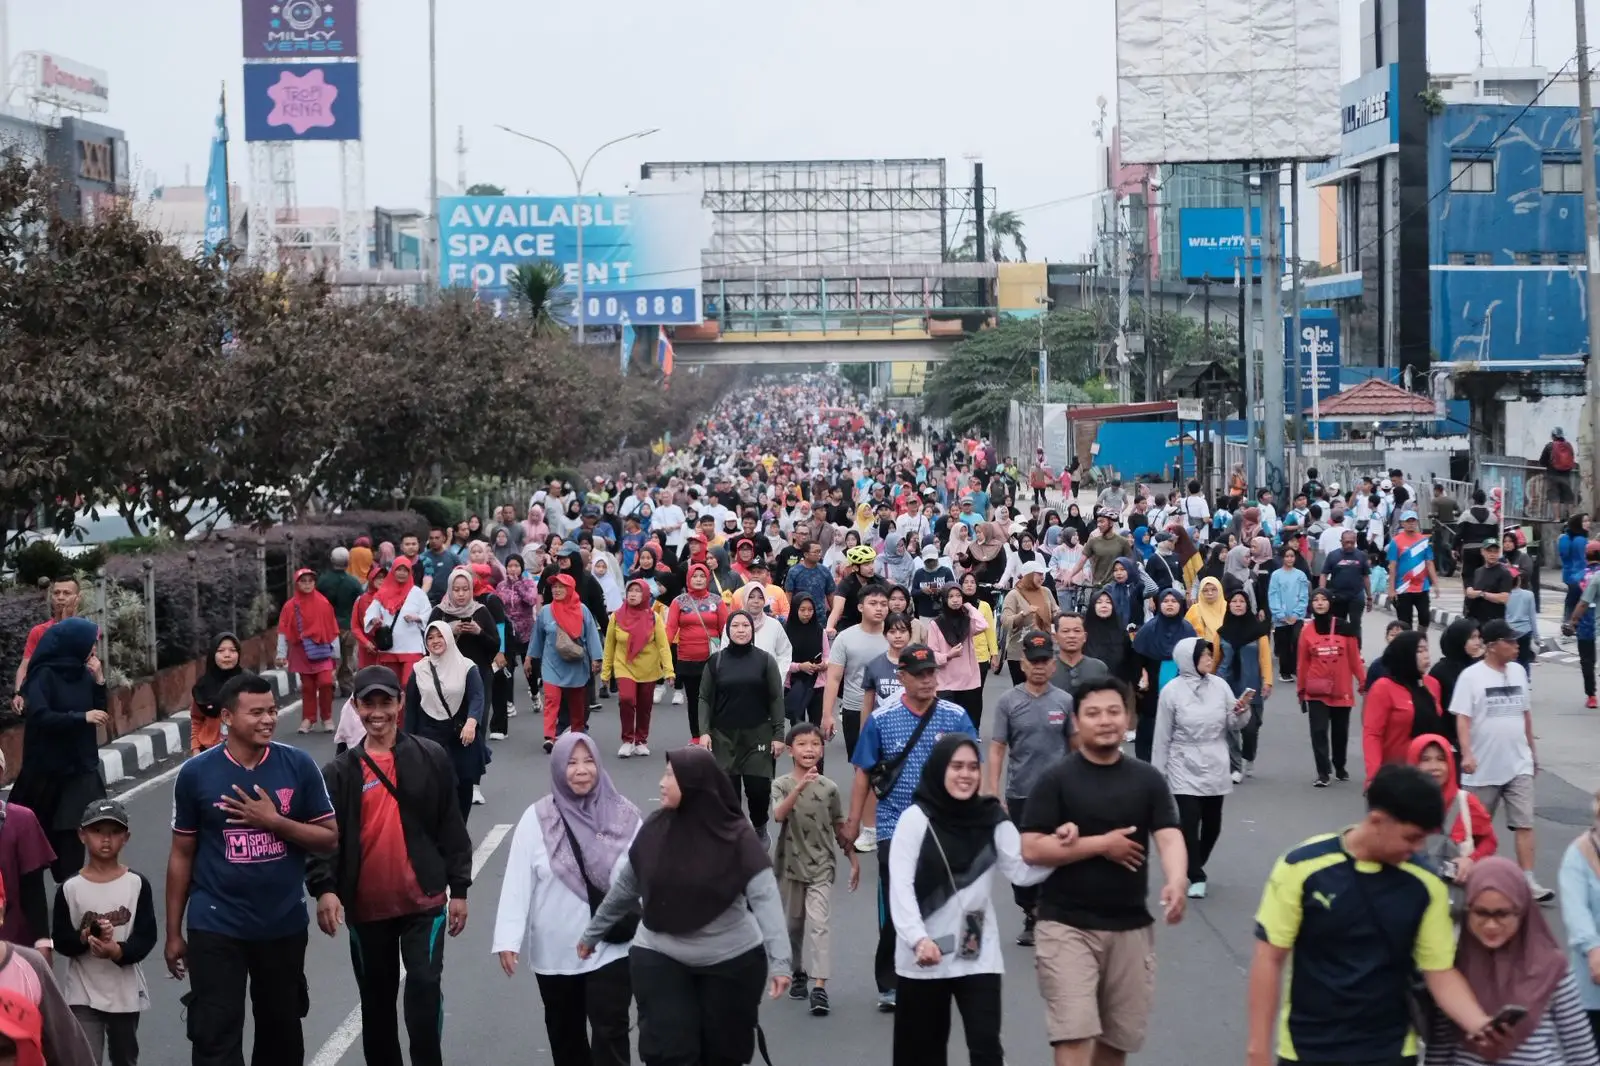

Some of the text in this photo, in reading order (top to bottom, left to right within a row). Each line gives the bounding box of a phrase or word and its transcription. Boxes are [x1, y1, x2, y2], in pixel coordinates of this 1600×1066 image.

[268, 30, 336, 41] MILKY
[449, 204, 632, 226] AVAILABLE
[449, 233, 555, 257] SPACE
[1188, 236, 1217, 247] WILL
[635, 296, 683, 316] 888
